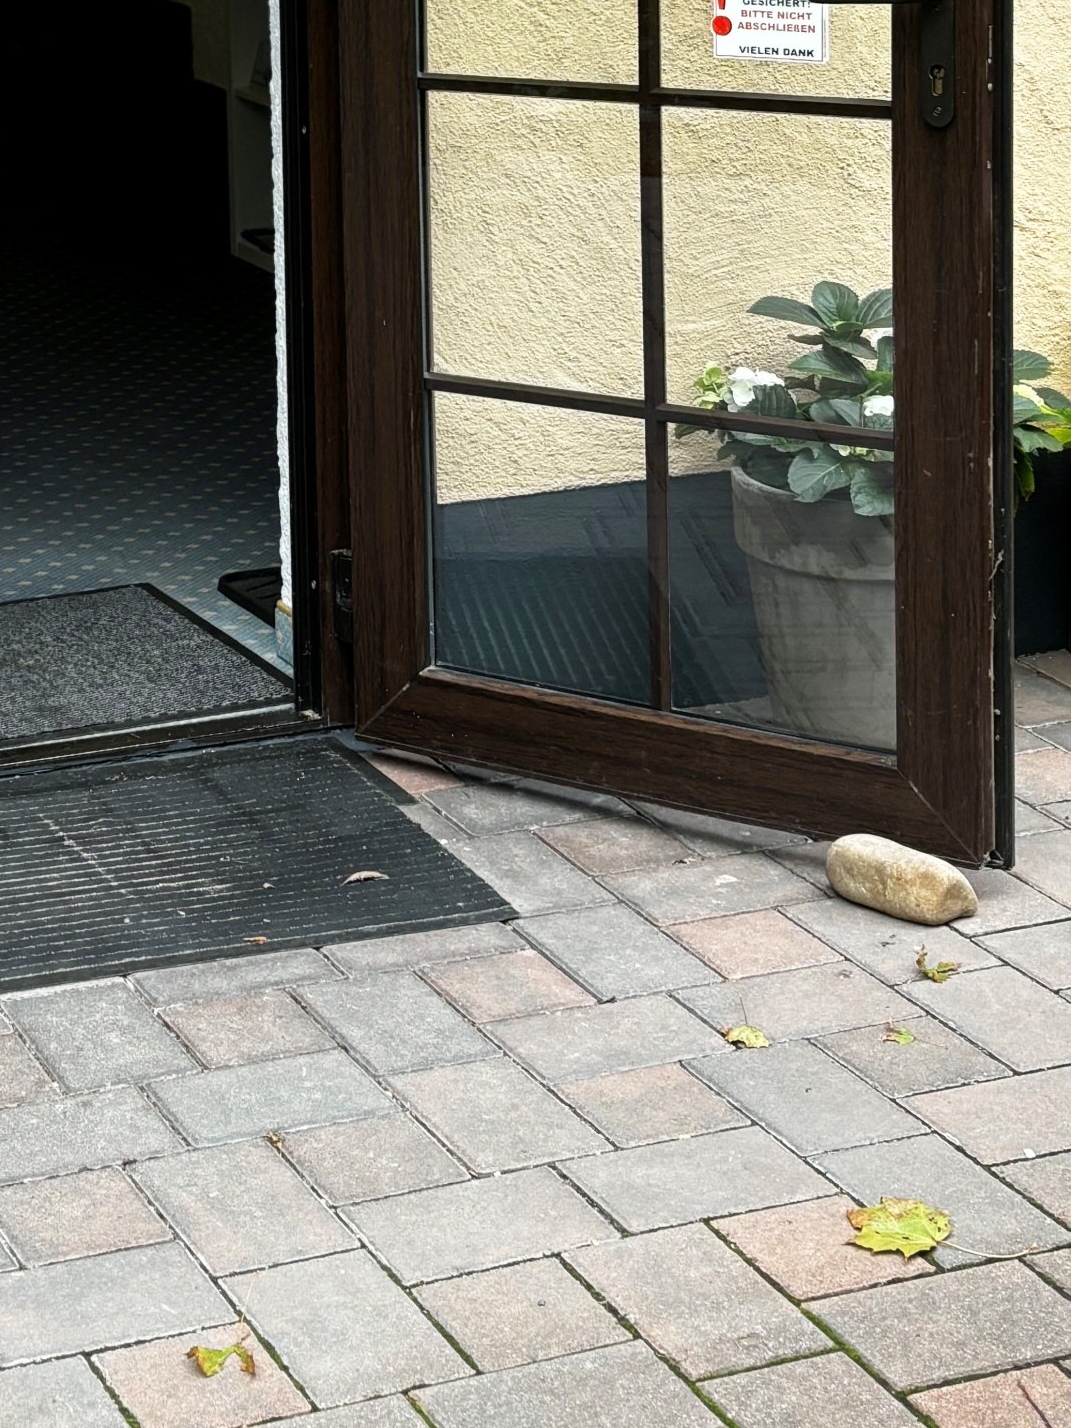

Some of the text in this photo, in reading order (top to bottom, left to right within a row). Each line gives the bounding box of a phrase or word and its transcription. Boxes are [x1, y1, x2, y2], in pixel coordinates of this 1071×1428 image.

[741, 10, 812, 21] BITTE NICHT
[739, 46, 815, 58] VIELEN DANK
